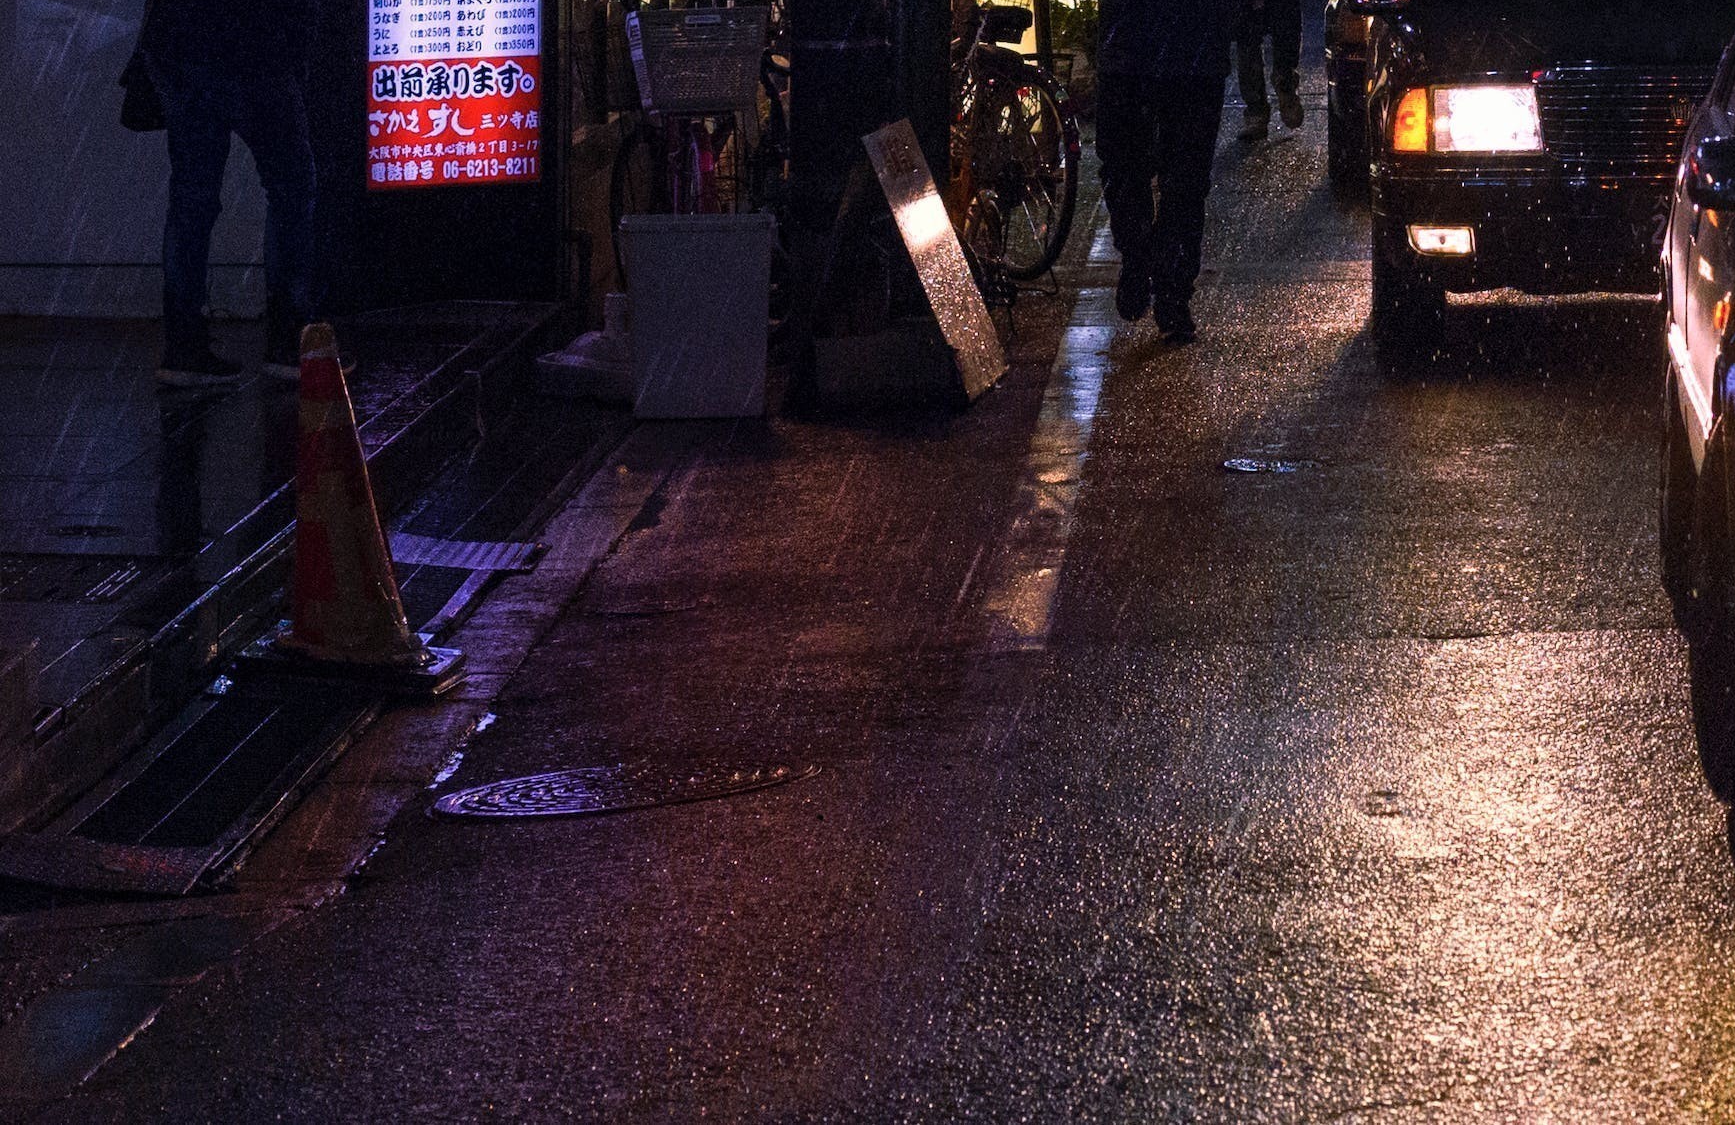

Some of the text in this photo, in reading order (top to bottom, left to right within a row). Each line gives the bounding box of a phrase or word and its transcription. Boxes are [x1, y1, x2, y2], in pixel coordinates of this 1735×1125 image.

[373, 12, 401, 24] うなぎ
[457, 9, 486, 21] あわび
[373, 29, 390, 40] うに
[373, 44, 399, 56] 上とろ
[456, 40, 483, 53] おどり
[374, 64, 534, 98] 出前承ります。
[480, 110, 539, 130] 三ツ寺店
[371, 156, 536, 183] 電話番号 06-6213-8211
